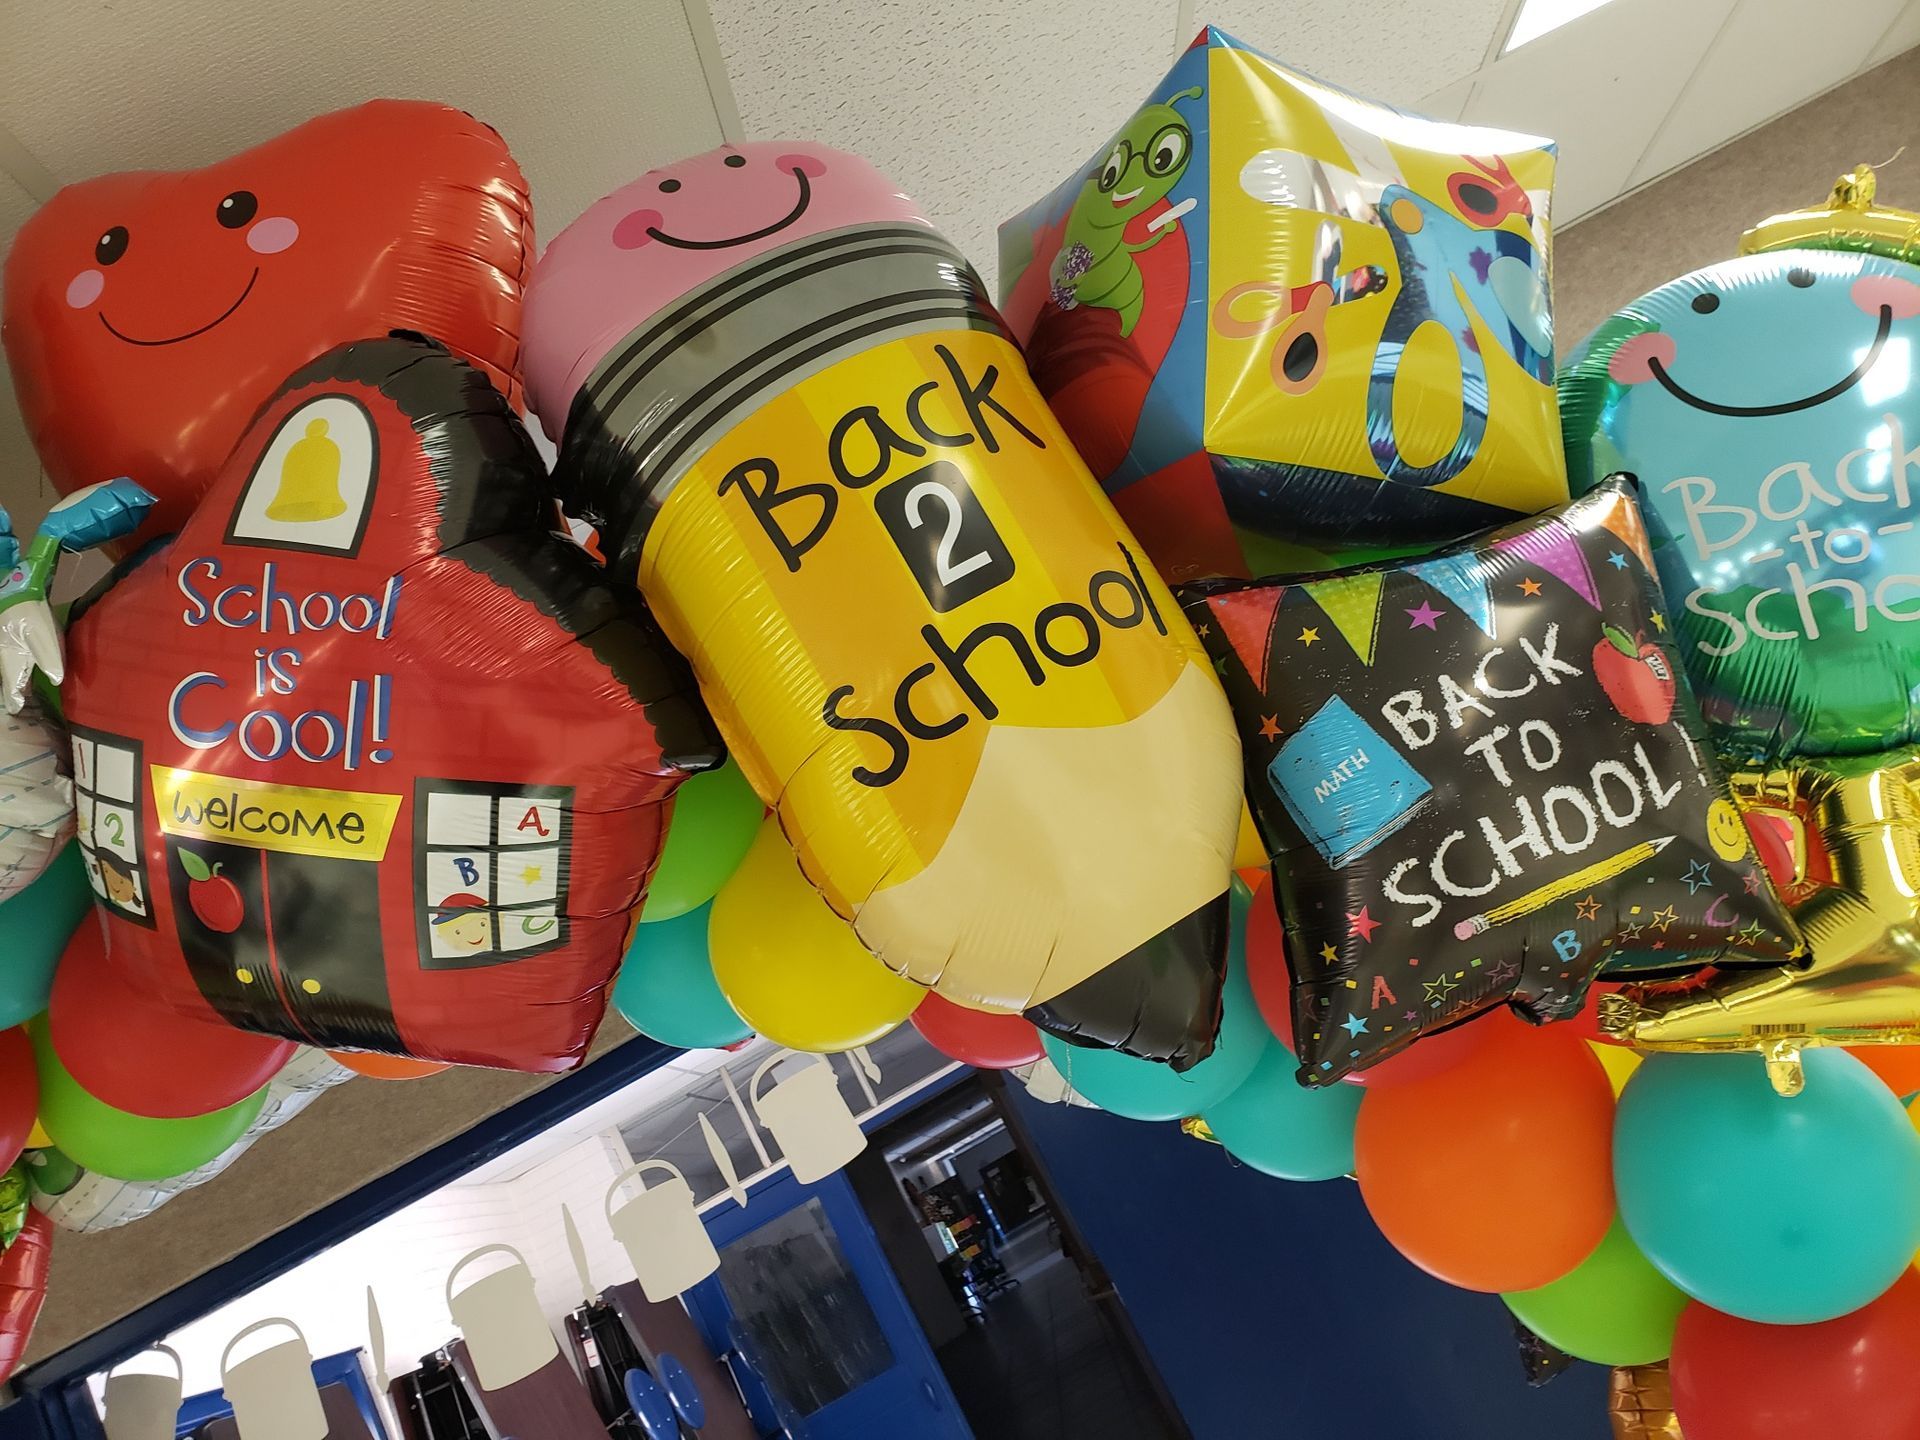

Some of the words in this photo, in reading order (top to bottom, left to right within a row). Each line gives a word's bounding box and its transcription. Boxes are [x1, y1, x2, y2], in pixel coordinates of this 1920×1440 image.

[718, 343, 1047, 573] Back
[903, 481, 995, 588] 2
[1749, 519, 1914, 570] -to-
[177, 556, 403, 641] School
[255, 647, 301, 698] is
[822, 541, 1169, 788] School
[1380, 621, 1584, 751] BACK
[166, 671, 395, 771] Cool!
[1313, 748, 1371, 804] MATH
[1463, 718, 1561, 787] TO
[103, 812, 126, 848] 2
[516, 806, 551, 837] A
[1380, 720, 1709, 928] SCHOOL!
[452, 857, 481, 887] B
[1551, 929, 1583, 962] B
[1371, 975, 1397, 1010] A
